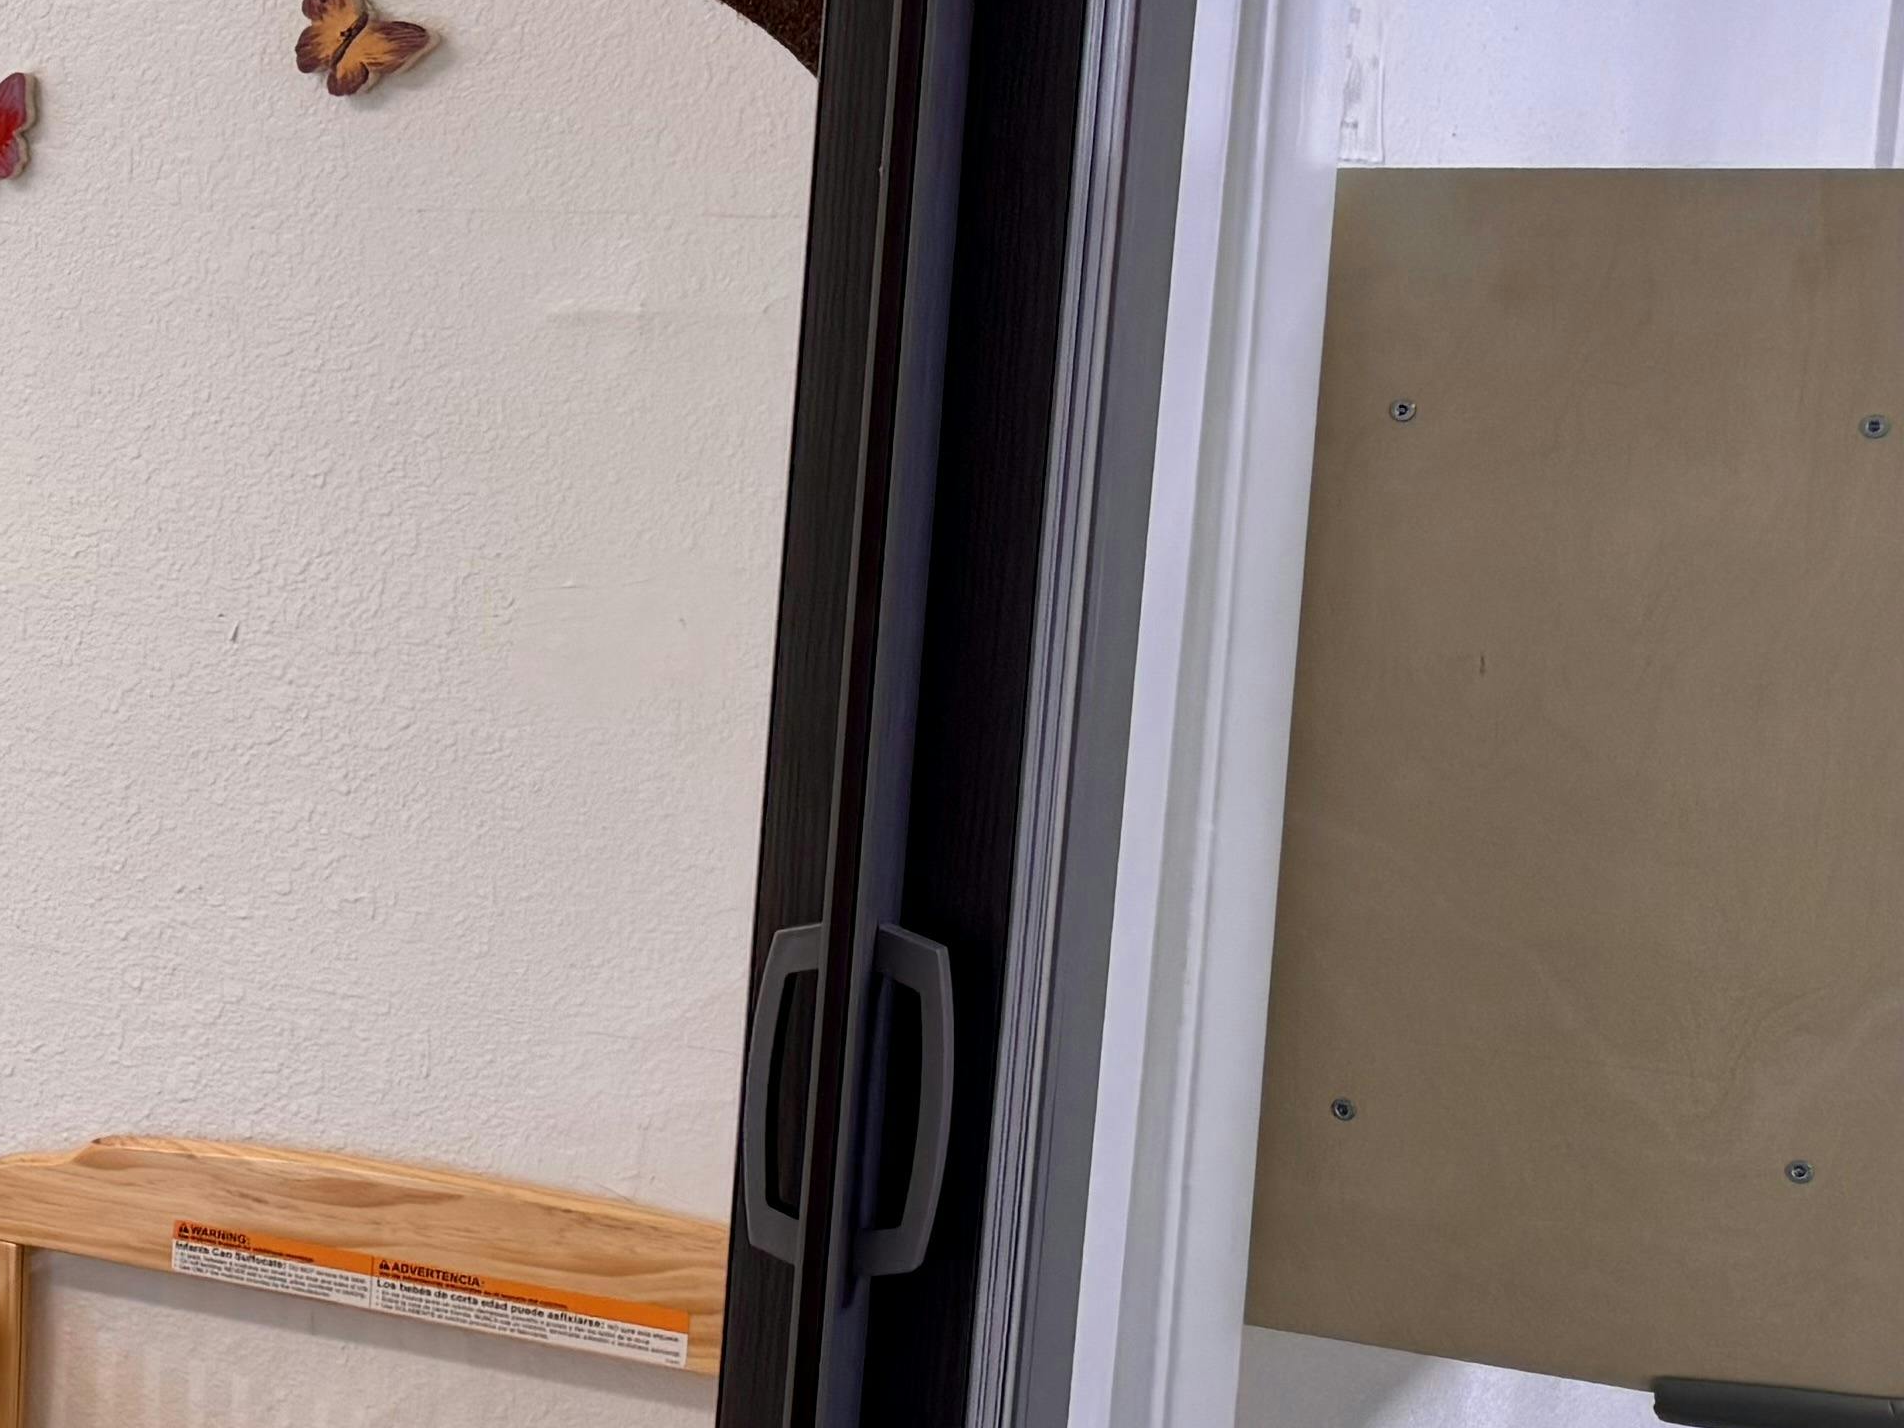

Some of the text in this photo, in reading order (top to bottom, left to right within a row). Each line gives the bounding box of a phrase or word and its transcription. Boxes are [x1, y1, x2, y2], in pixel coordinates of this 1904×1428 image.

[212, 1245, 233, 1260] Can
[376, 1279, 396, 1291] Los
[434, 1287, 448, 1300] de
[450, 1291, 479, 1306] corta
[481, 1295, 508, 1311] edad
[510, 1304, 545, 1319] puede
